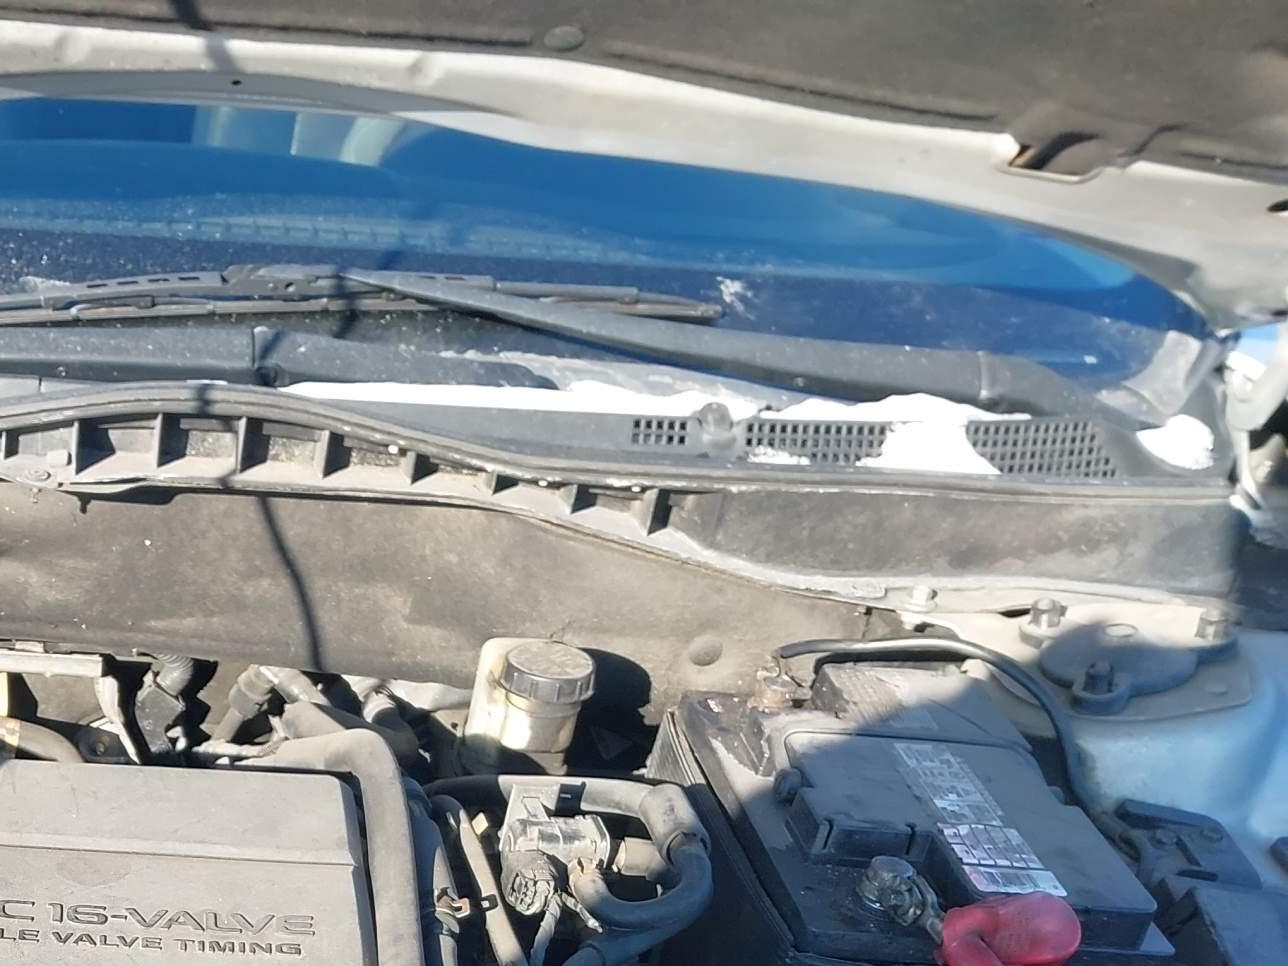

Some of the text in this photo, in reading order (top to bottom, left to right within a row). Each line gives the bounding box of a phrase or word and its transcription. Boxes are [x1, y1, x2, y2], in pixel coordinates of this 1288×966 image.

[48, 902, 316, 937] 16-VALVE
[51, 931, 163, 951] VALVE
[173, 938, 303, 957] TIMING
